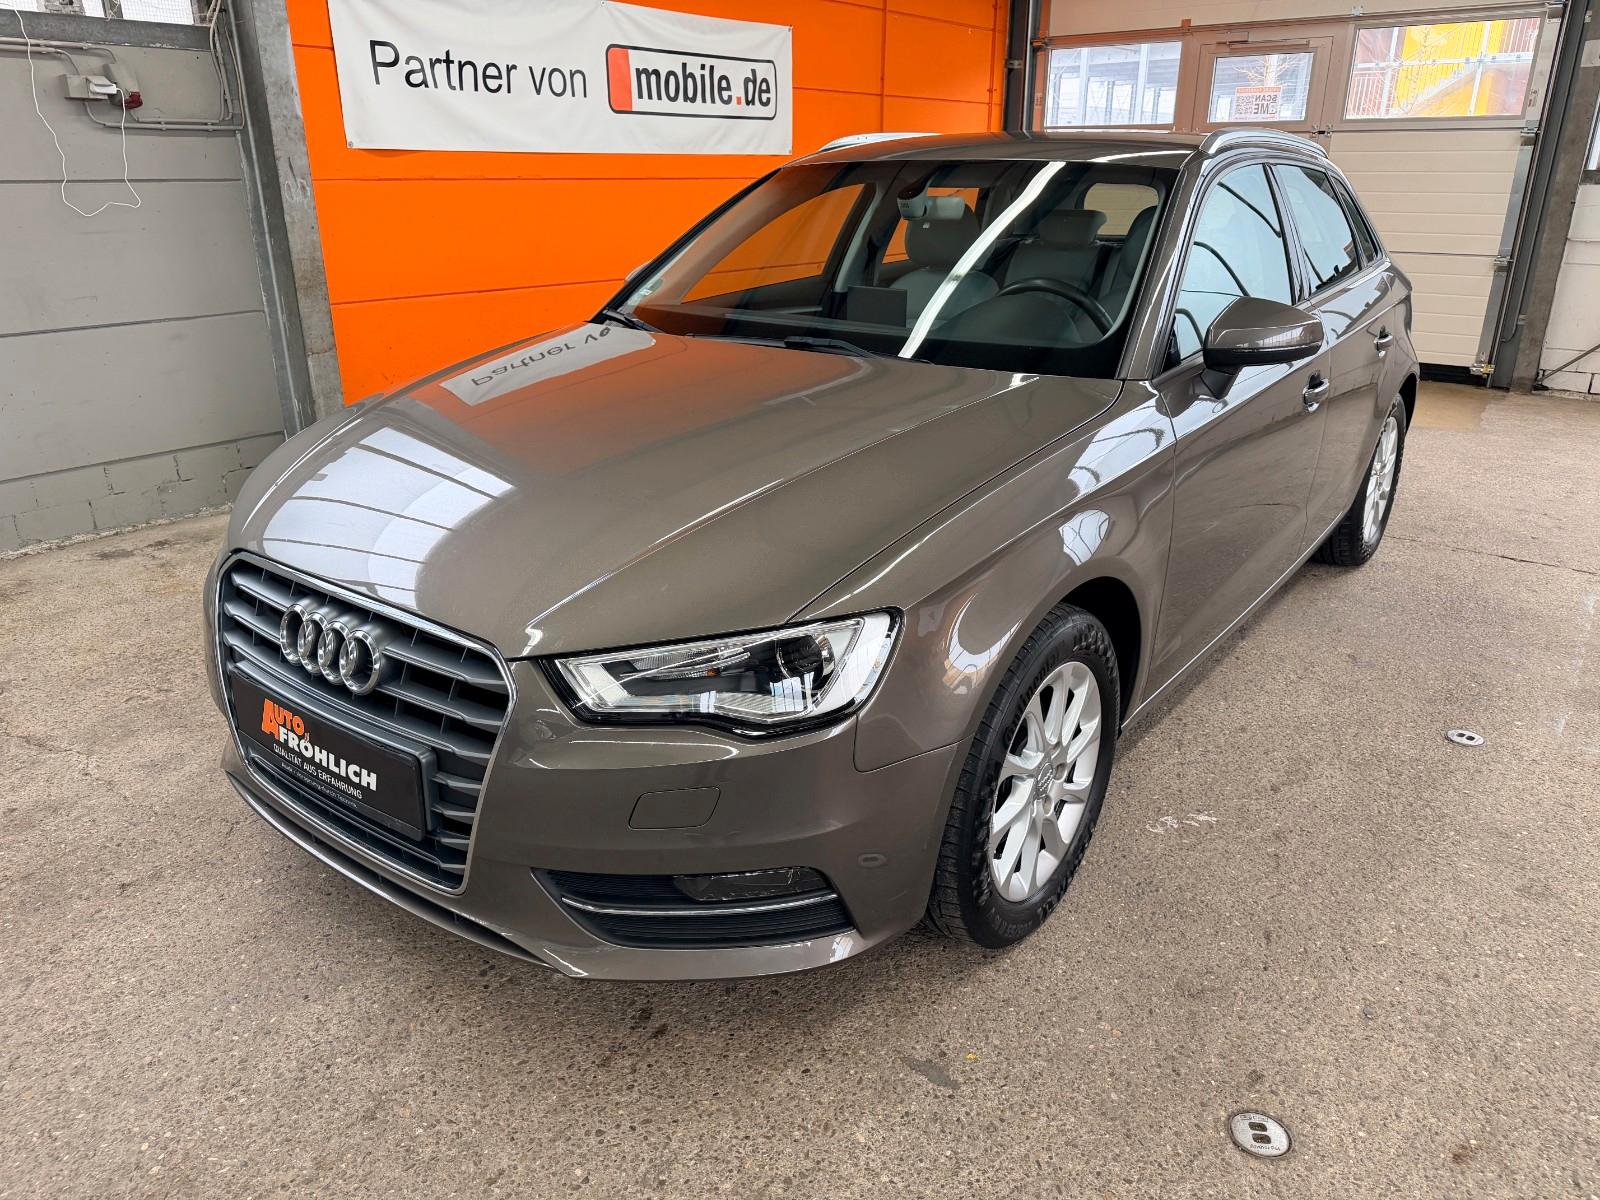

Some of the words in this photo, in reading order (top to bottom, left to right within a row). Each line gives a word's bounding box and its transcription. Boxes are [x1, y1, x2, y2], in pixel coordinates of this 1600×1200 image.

[369, 39, 518, 94] Partner
[528, 65, 588, 98] von
[634, 62, 772, 107] mobile.de
[261, 698, 305, 740] AUTO
[273, 743, 302, 768] QUALITÄT
[303, 762, 317, 776] AUS
[318, 769, 363, 799] ERFAHRUNG
[279, 725, 377, 792] FRÖHLICH
